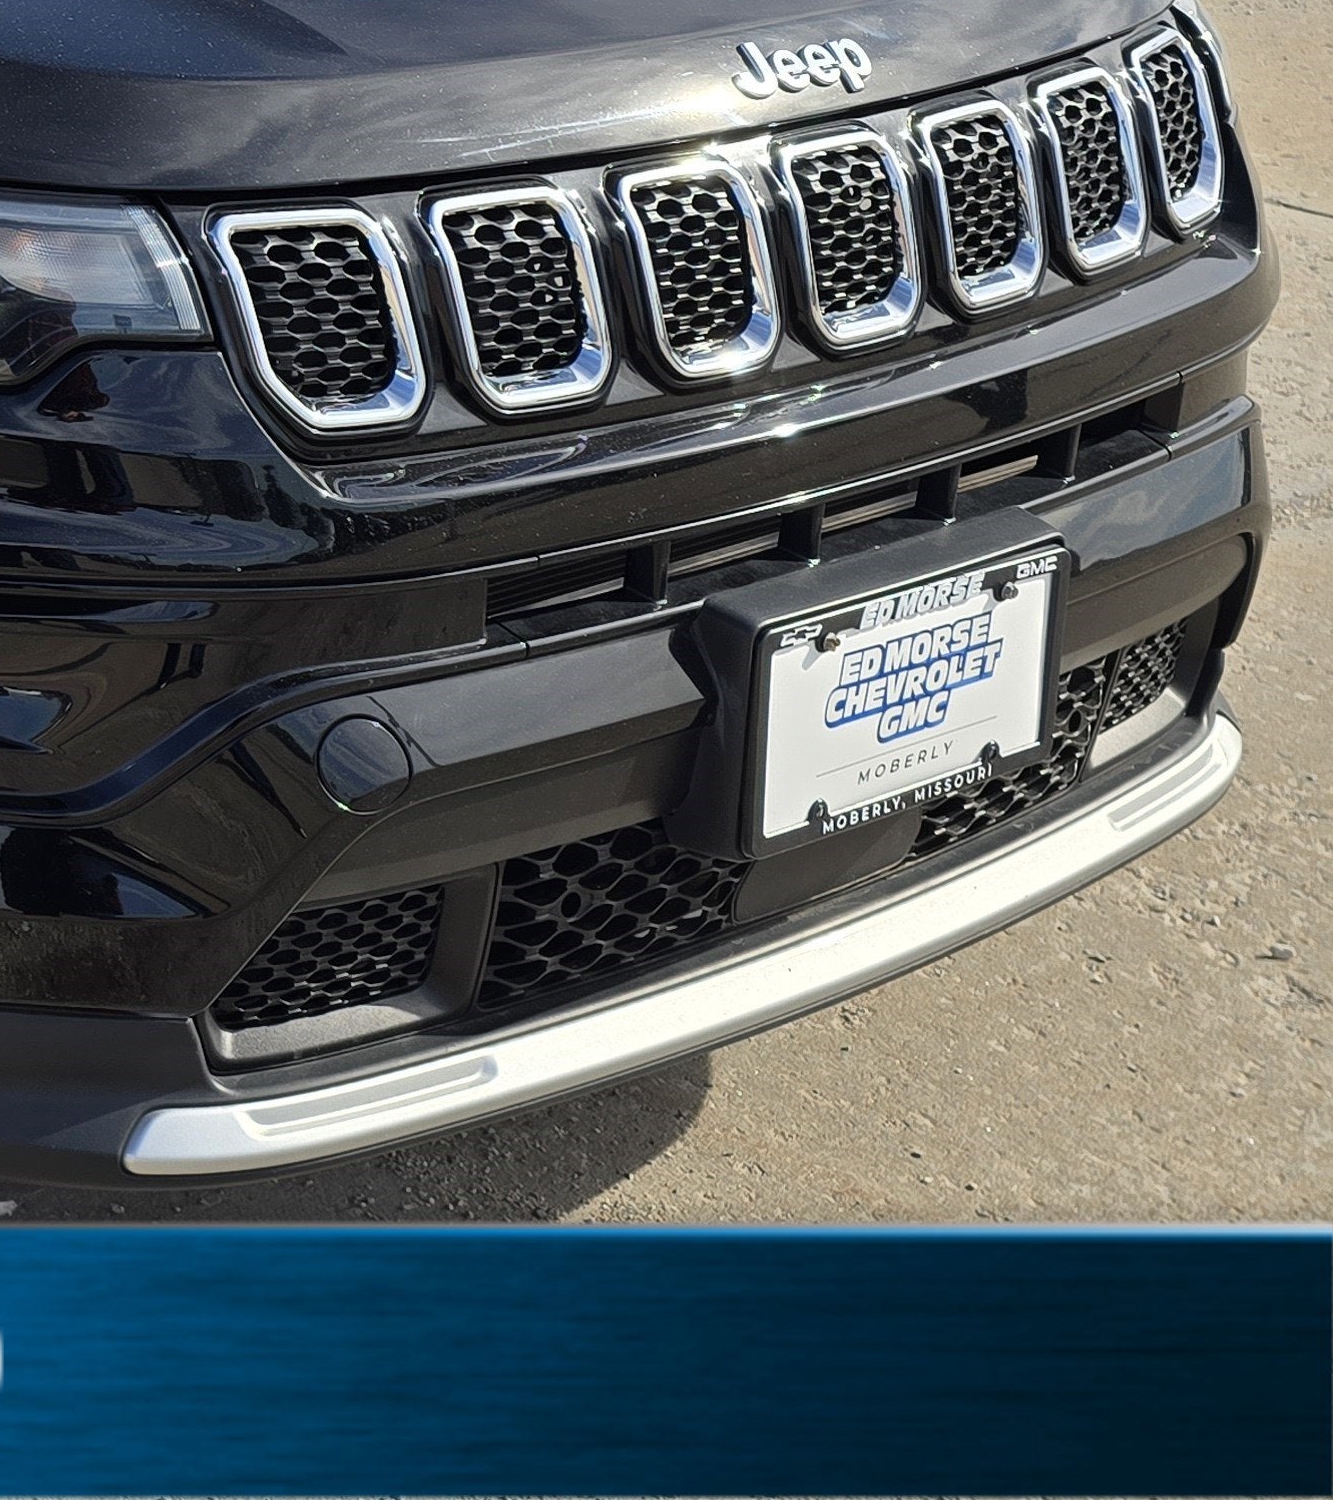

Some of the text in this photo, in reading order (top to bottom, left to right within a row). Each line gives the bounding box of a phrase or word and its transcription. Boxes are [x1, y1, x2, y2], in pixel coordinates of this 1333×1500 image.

[732, 38, 872, 100] Jeep
[1016, 555, 1058, 579] GMC
[859, 572, 985, 630] ED MORSE
[840, 612, 991, 686] ED MORSE
[825, 638, 1003, 728] CHEVROLET
[878, 691, 951, 743] GMC
[857, 740, 953, 785] MOBERLY
[822, 763, 993, 834] MOBERLY, MISSOURI
